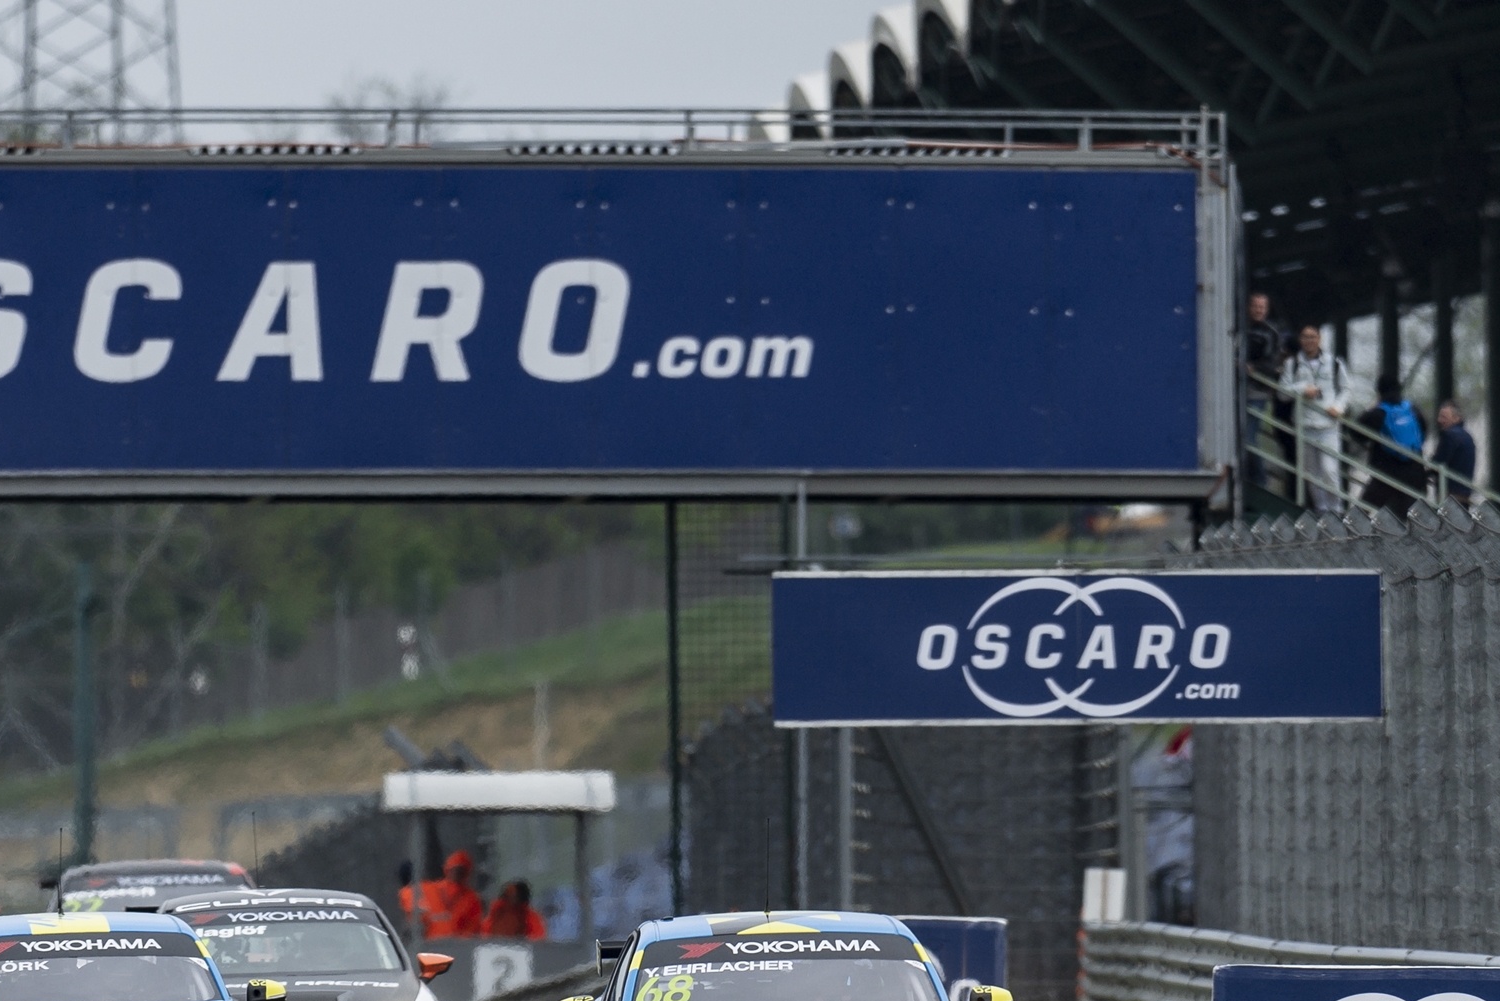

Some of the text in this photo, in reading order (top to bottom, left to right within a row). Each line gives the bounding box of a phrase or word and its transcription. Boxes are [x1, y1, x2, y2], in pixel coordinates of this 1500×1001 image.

[917, 623, 1230, 670] OSCARO
[1175, 682, 1241, 700] .com
[176, 897, 363, 912] CUPRA
[228, 910, 359, 922] YOKOHAMA
[20, 938, 162, 953] YOKOHAMA
[726, 939, 881, 954] YOKOHAMA
[644, 960, 794, 978] Y. EHRLACHER
